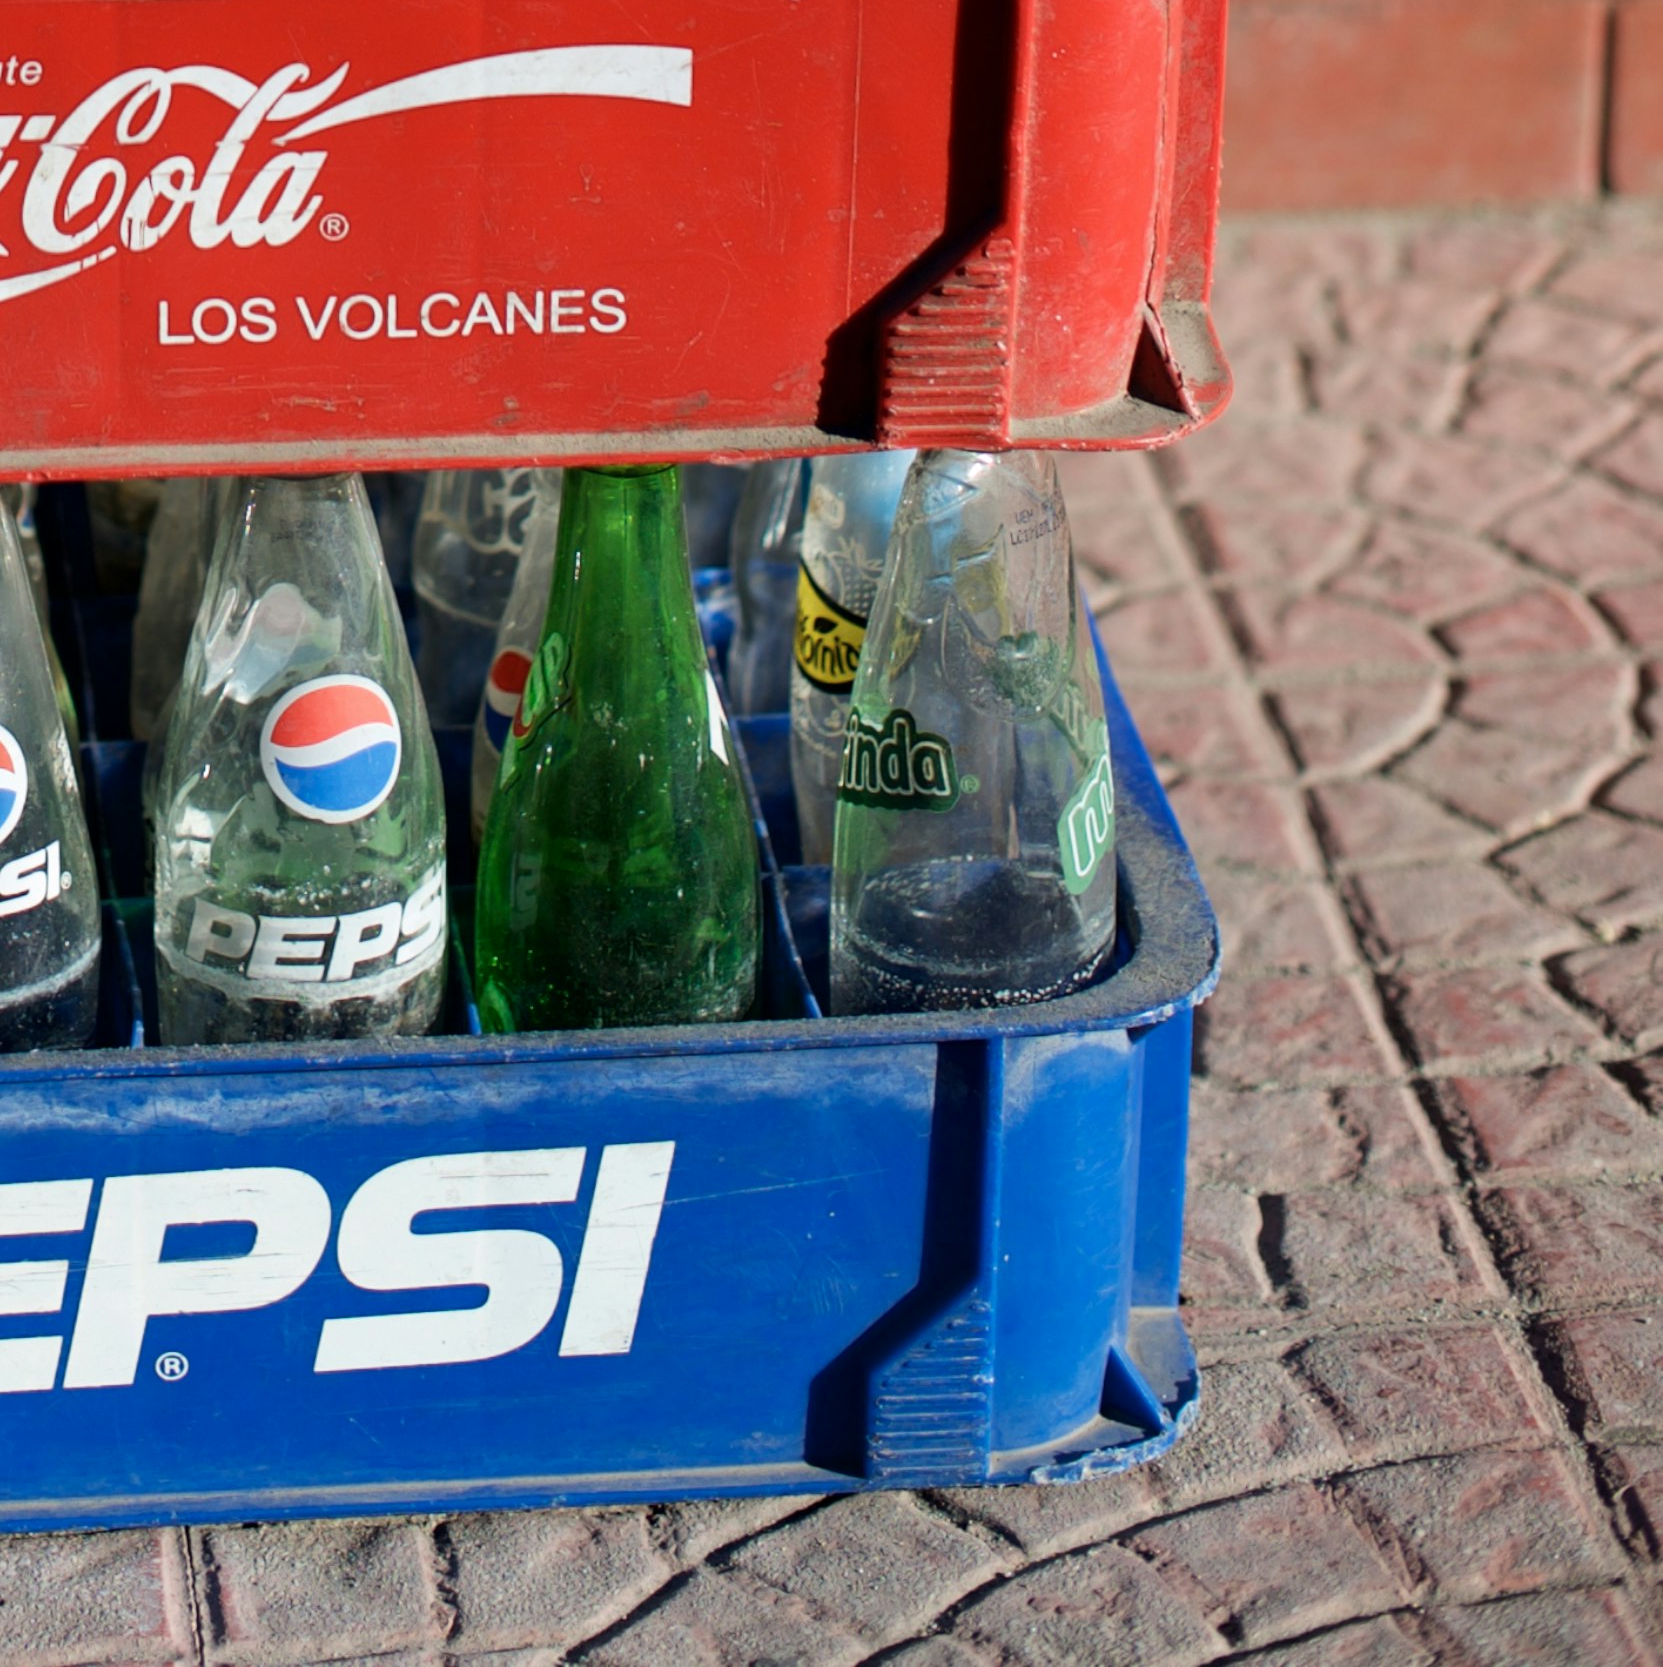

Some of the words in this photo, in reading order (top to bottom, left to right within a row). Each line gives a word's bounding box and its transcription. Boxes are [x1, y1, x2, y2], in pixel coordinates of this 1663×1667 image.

[158, 297, 278, 347] LOS
[302, 287, 629, 342] VOLCANES
[184, 861, 447, 982] PEPS
